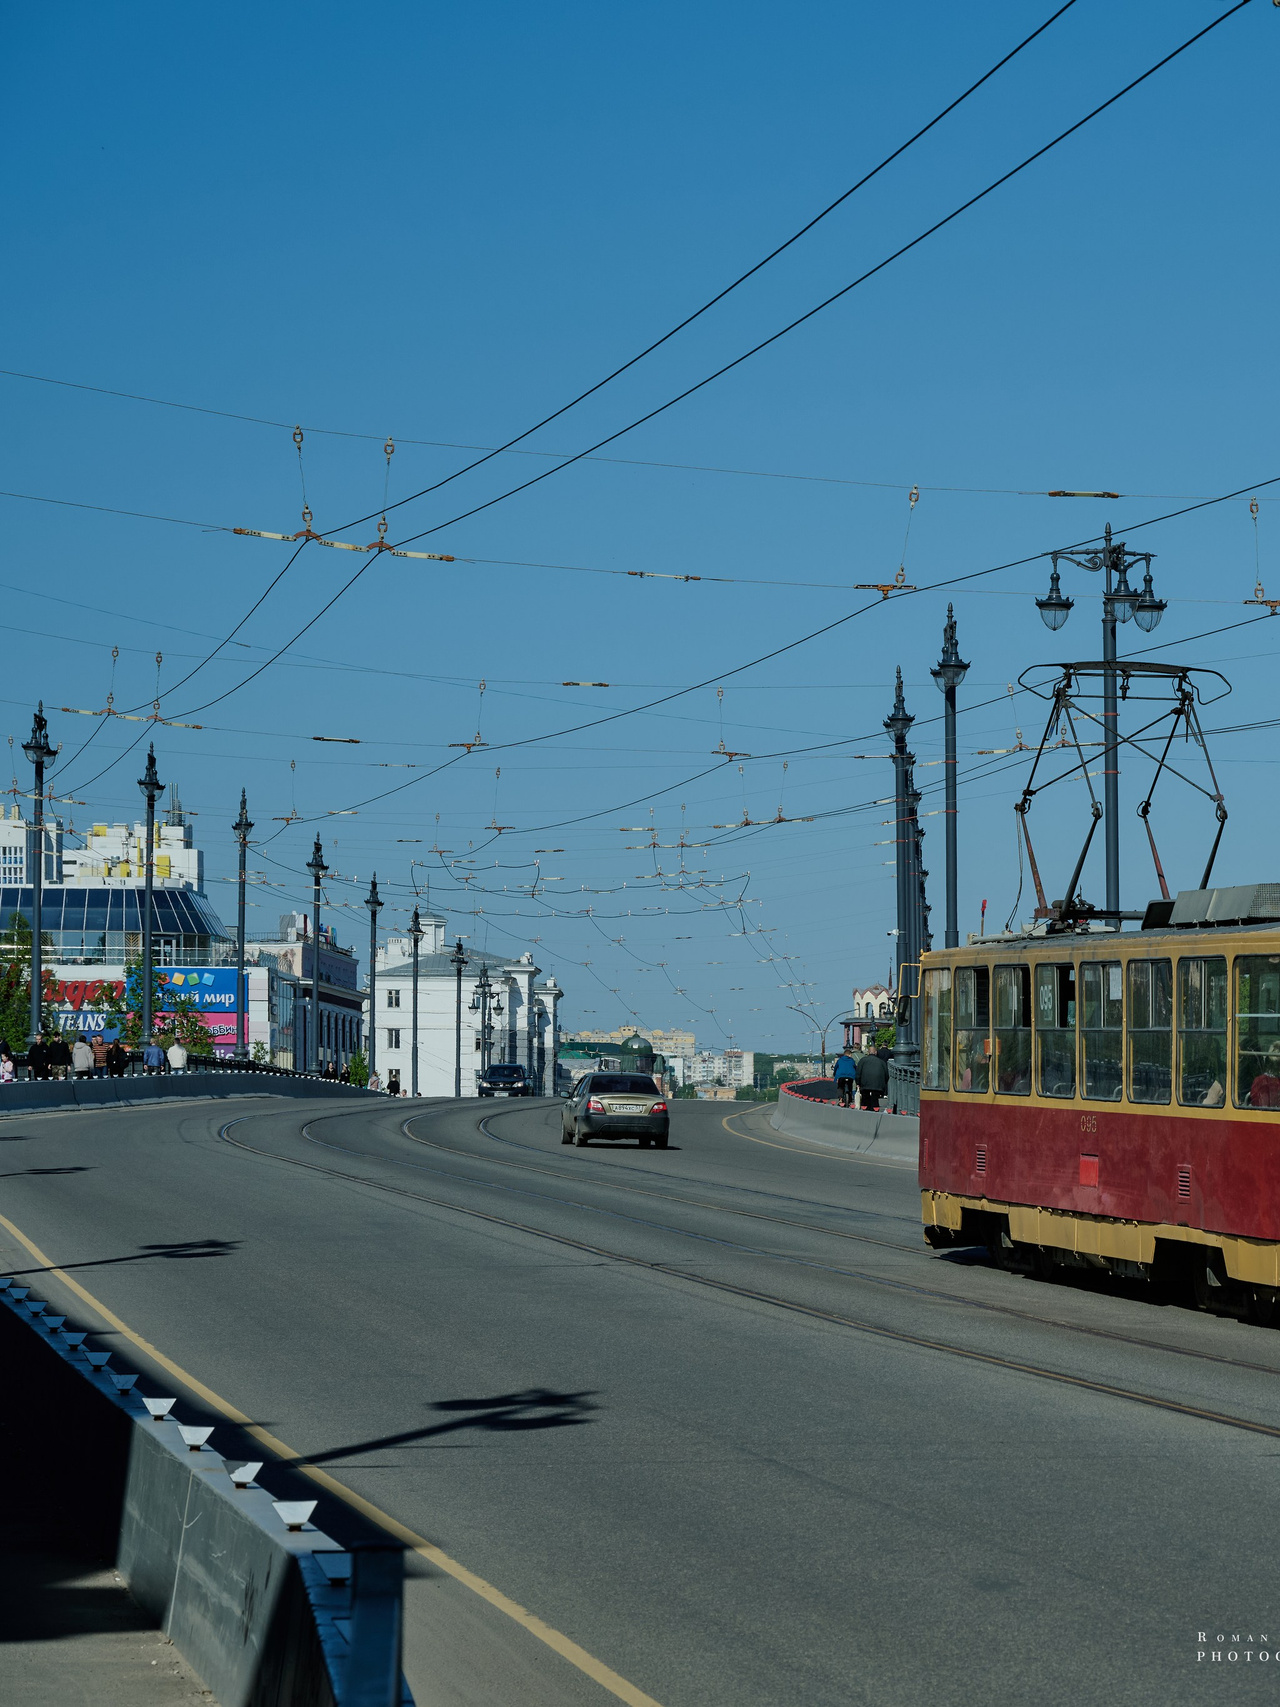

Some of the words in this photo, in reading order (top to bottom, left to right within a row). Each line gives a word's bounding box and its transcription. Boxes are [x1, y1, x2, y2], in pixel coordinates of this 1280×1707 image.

[203, 993, 235, 1007] мир
[59, 1014, 106, 1031] JEANS
[1080, 1115, 1097, 1132] 095
